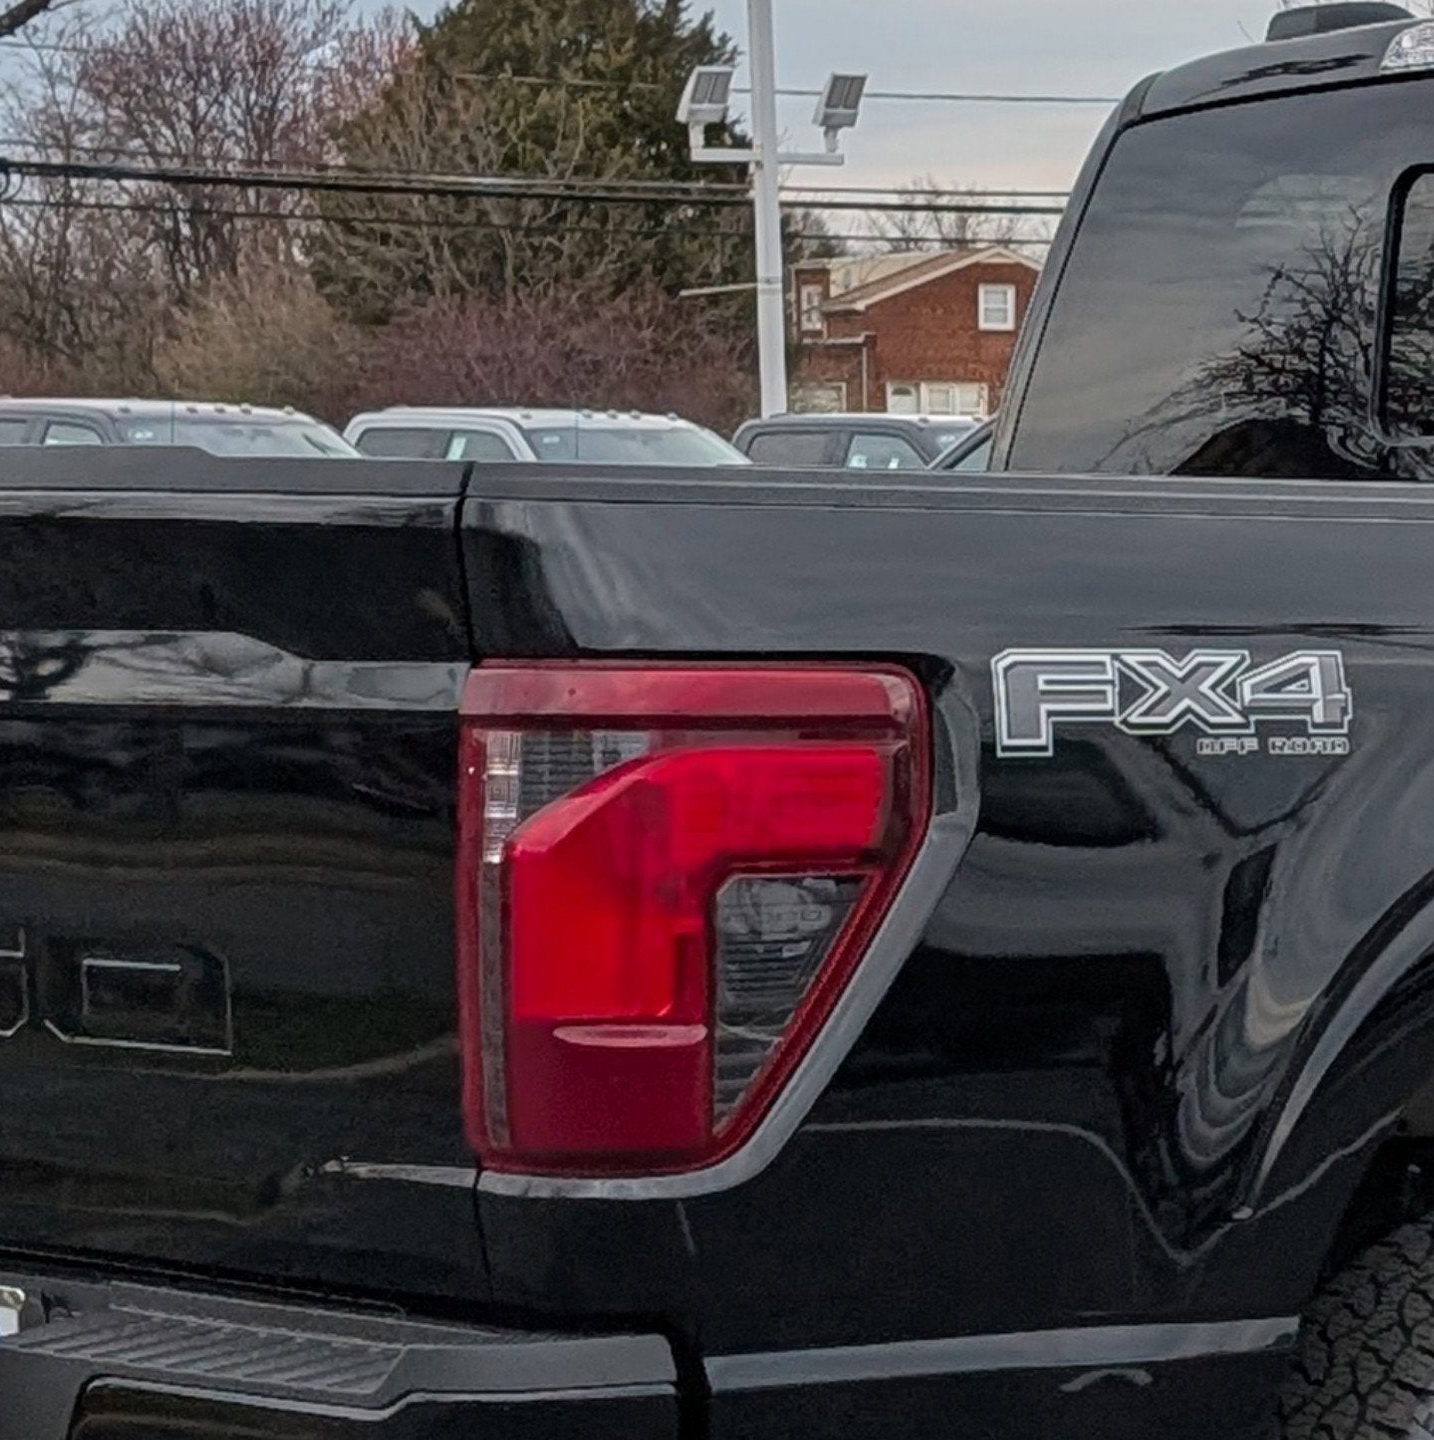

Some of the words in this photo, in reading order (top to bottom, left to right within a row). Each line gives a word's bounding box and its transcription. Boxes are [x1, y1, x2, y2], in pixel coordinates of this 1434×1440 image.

[991, 648, 1352, 758] FX4
[1197, 737, 1259, 755] OFF
[1268, 737, 1350, 755] ROAD
